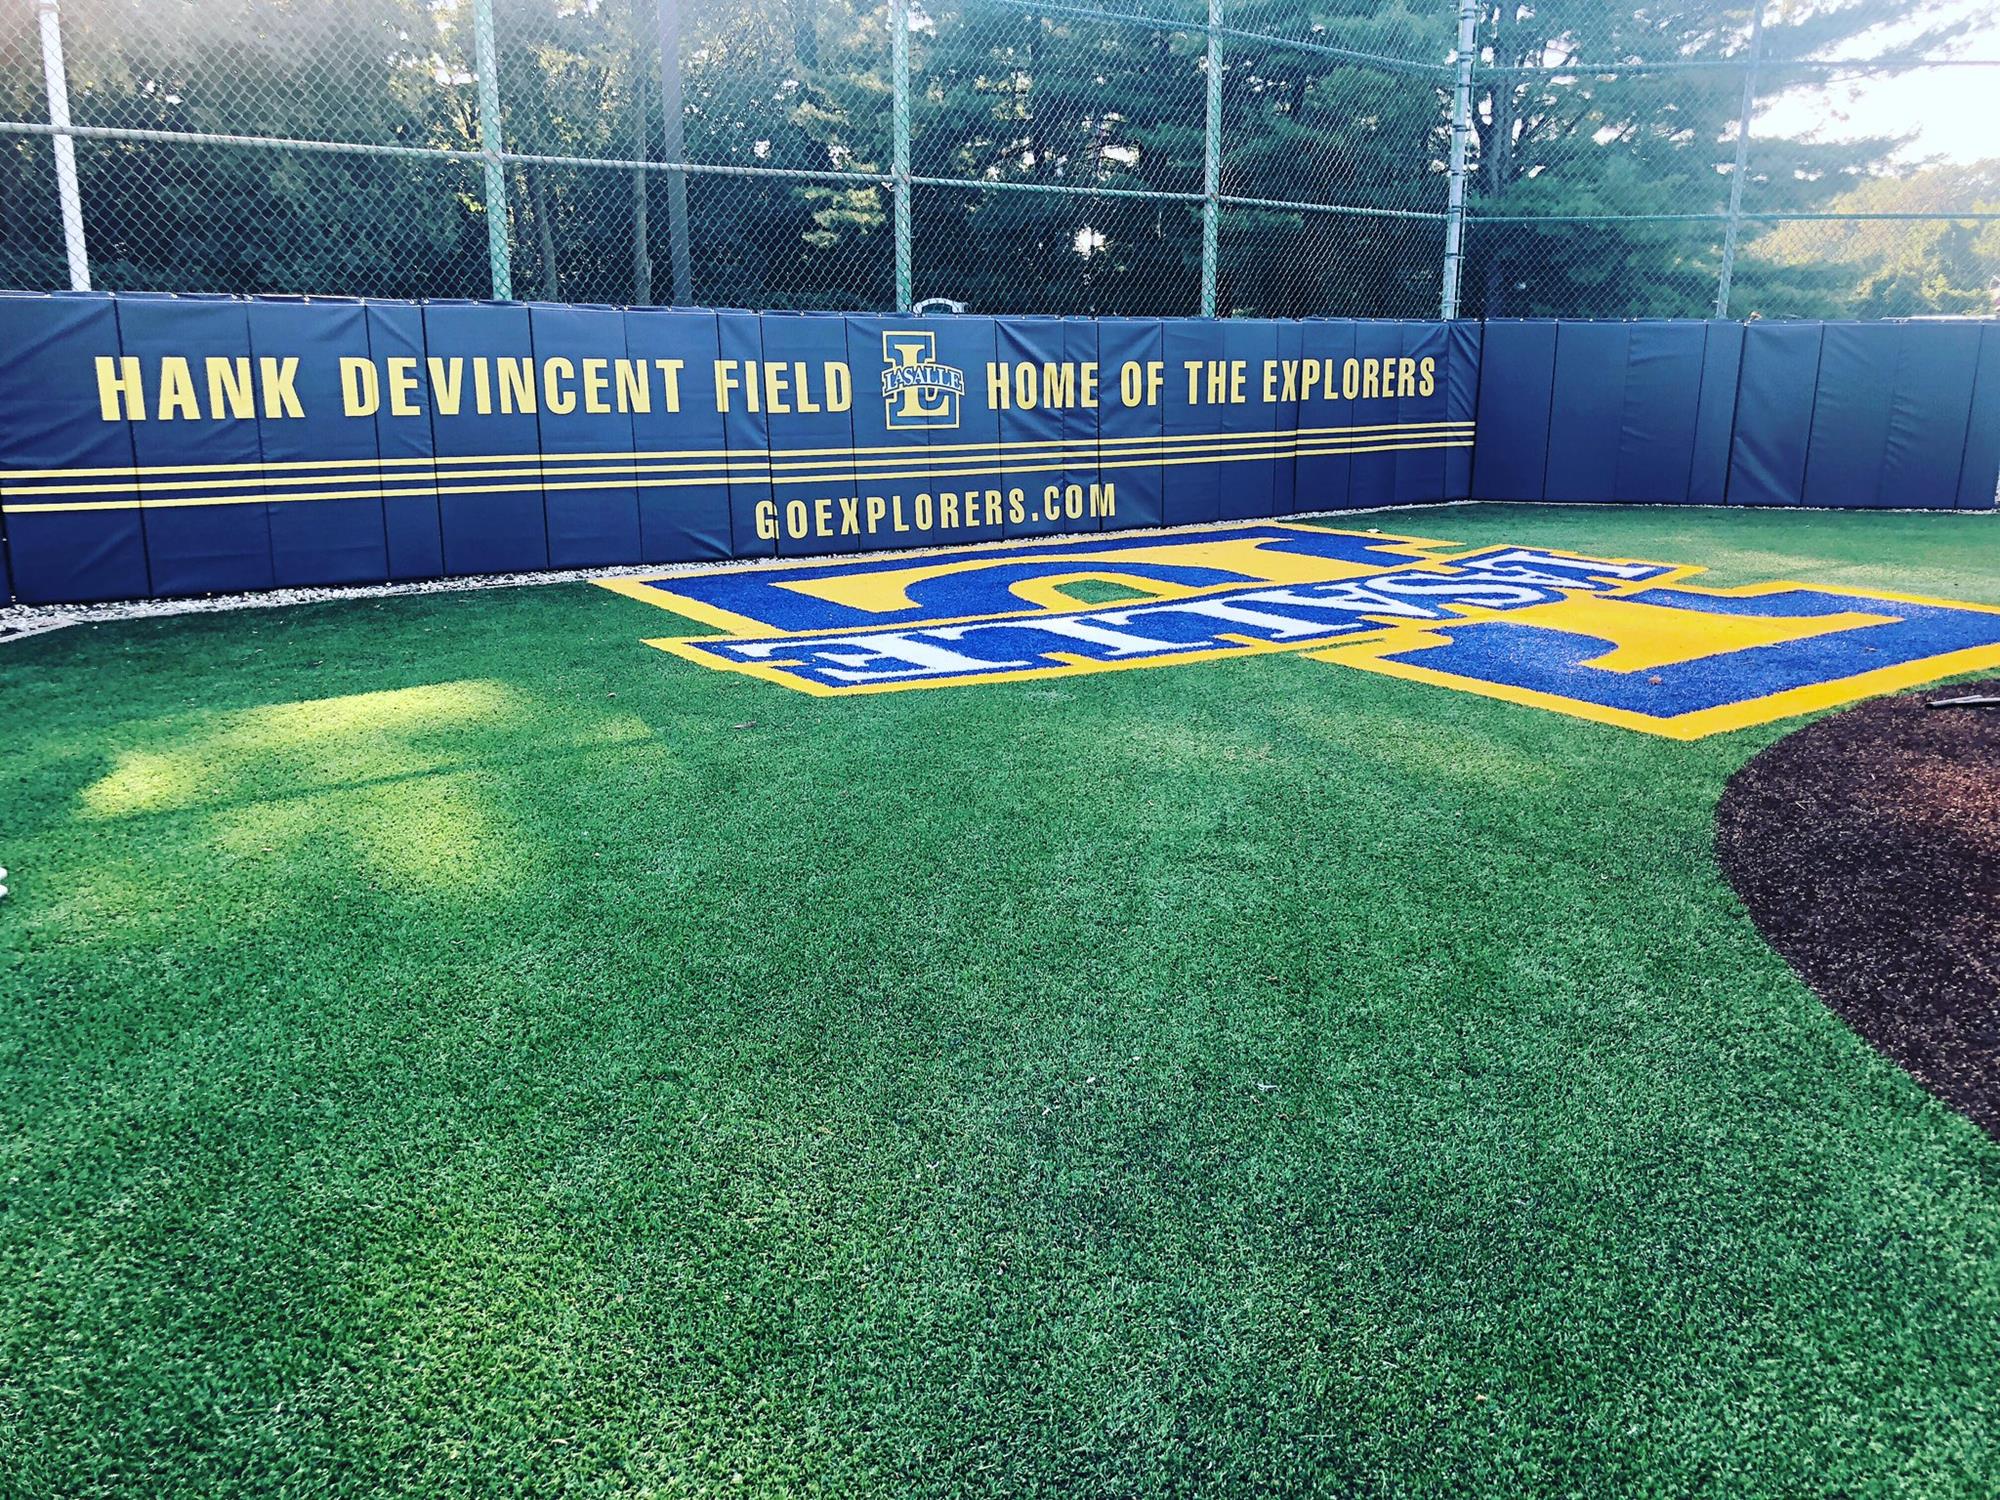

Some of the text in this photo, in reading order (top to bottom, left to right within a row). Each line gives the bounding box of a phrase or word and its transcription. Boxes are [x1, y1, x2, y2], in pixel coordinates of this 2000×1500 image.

[95, 355, 853, 421] HANK DEVINCENT FIELD
[884, 366, 963, 392] LASALLE
[986, 357, 1436, 410] HOME OF THE EXPLORERS
[755, 483, 1116, 540] GOEXPLORERS.COM
[735, 551, 1658, 682] LASALLE
